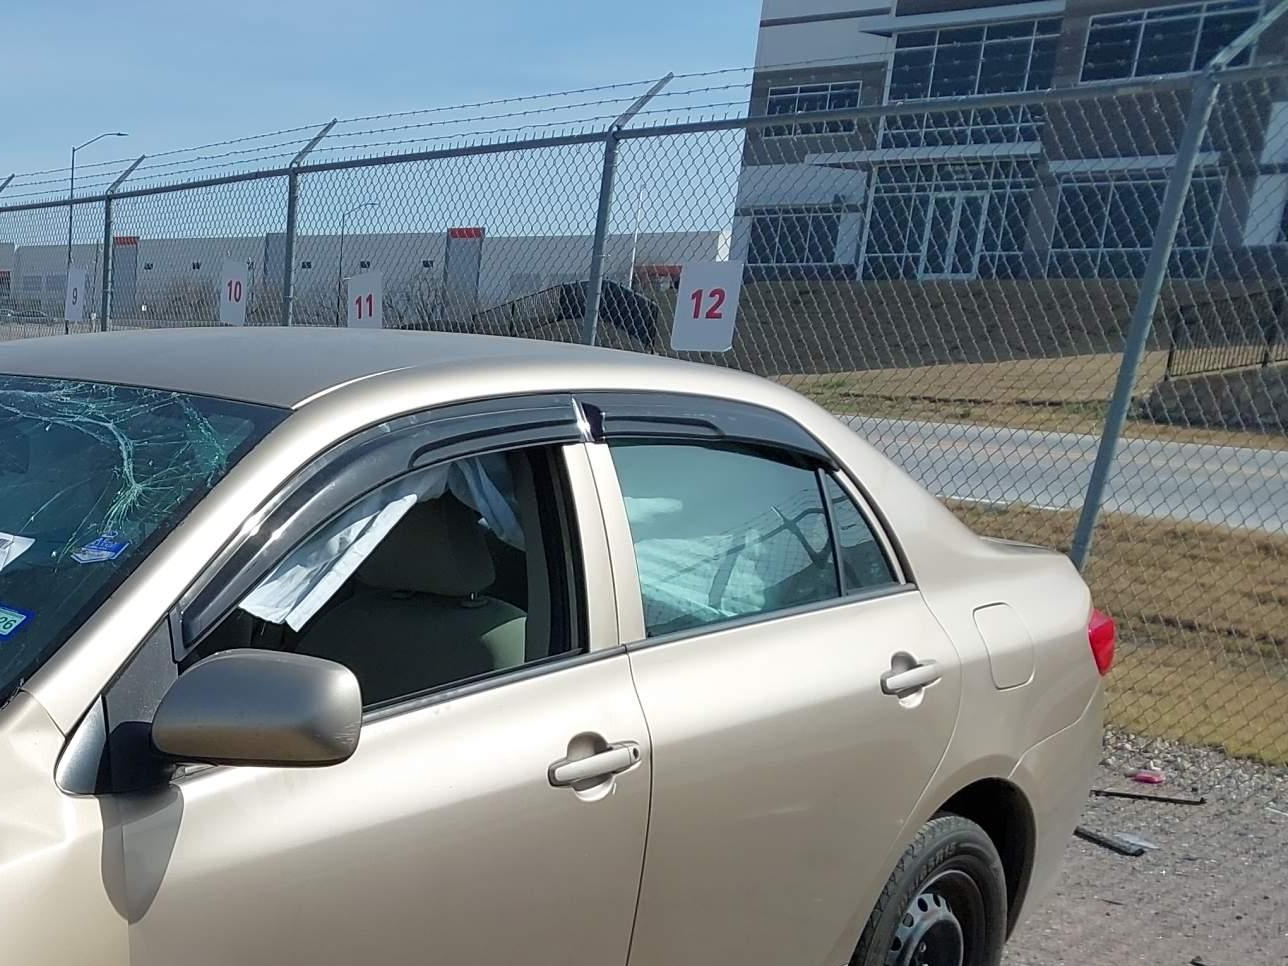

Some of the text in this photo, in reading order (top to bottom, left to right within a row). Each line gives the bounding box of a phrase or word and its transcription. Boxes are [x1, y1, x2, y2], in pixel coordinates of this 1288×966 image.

[72, 287, 78, 305] 9
[227, 279, 242, 303] 10
[691, 288, 726, 319] 12
[355, 293, 373, 319] 11
